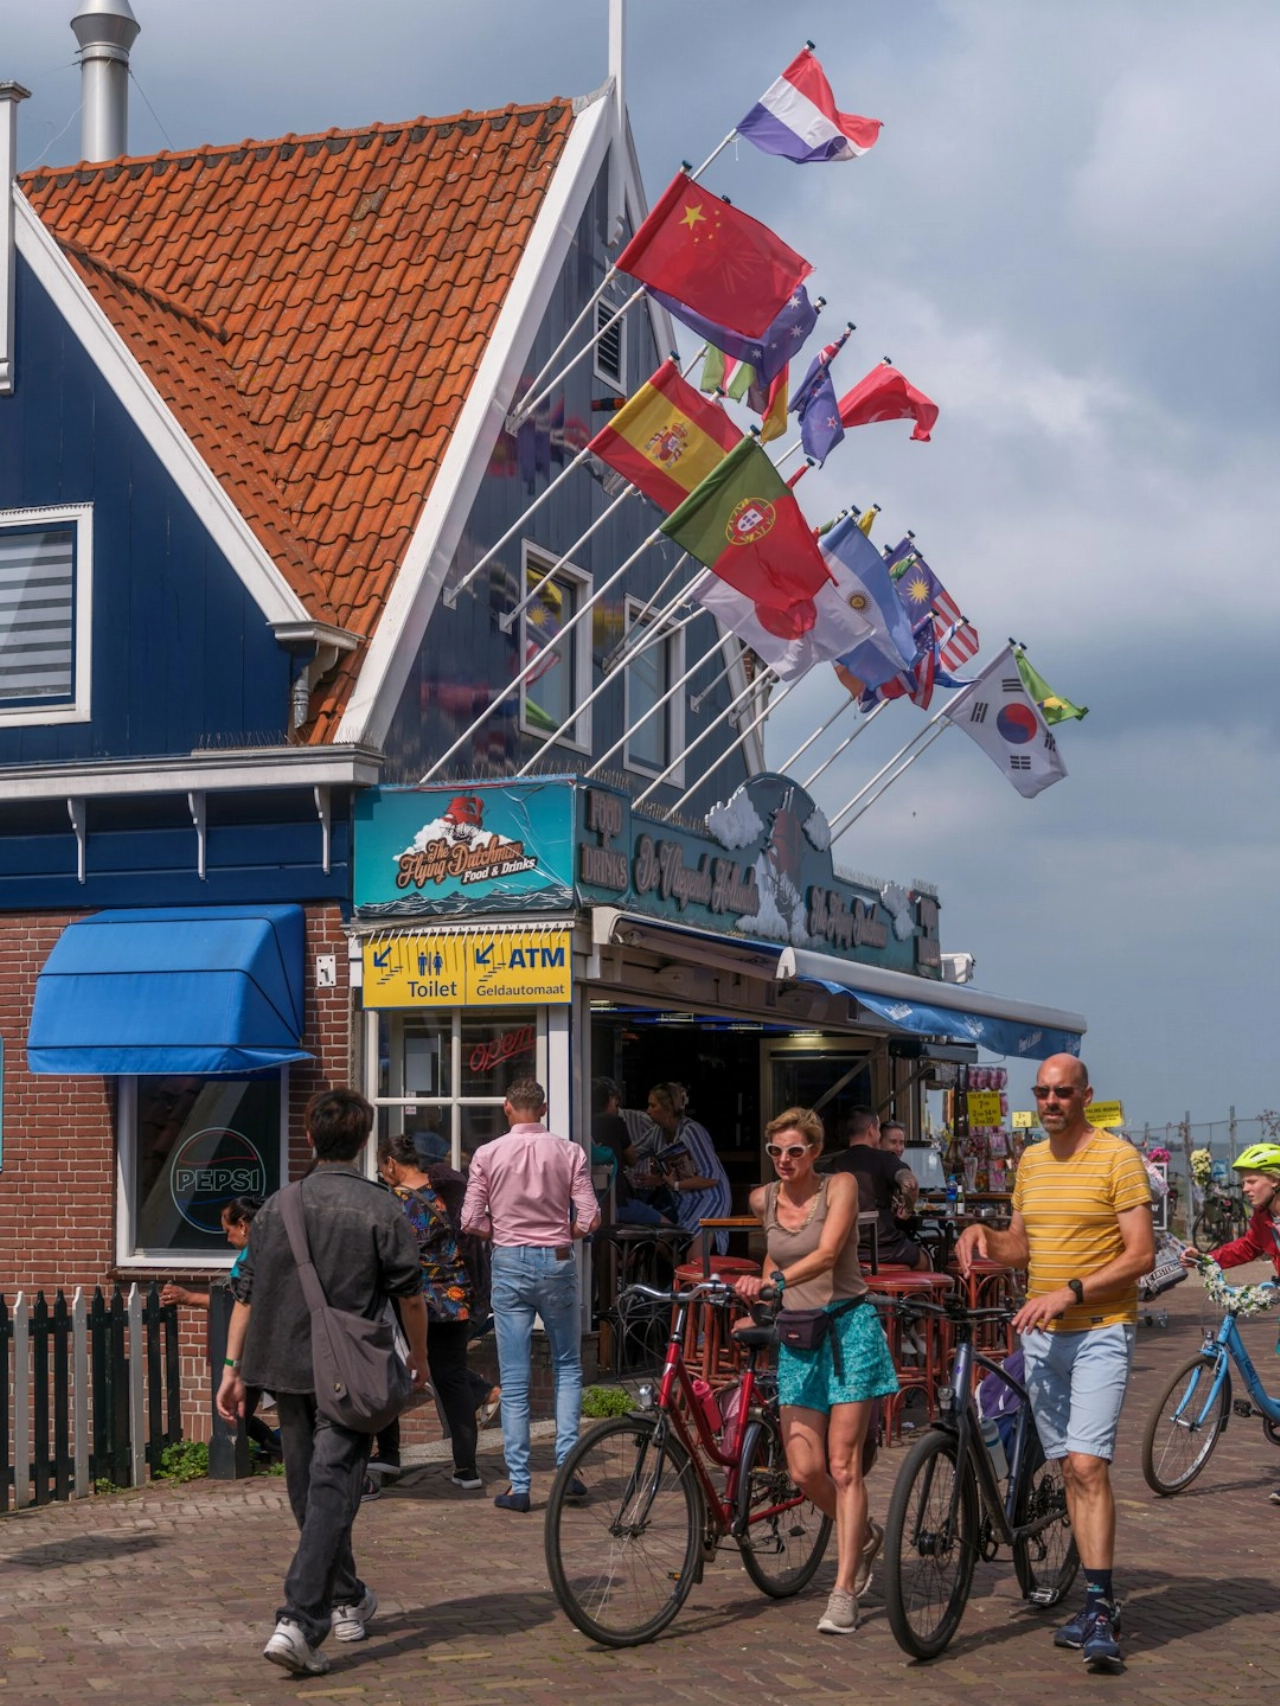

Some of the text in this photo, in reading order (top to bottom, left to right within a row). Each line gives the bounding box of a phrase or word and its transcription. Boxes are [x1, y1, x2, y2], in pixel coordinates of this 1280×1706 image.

[397, 835, 524, 888] Flying Dutchman
[428, 839, 450, 862] The
[463, 857, 536, 884] Food & Drinks
[585, 848, 628, 889] DRINKS
[508, 947, 565, 969] ATM
[407, 980, 457, 998] Toilet
[476, 983, 565, 997] Geldautomaat
[176, 1168, 260, 1192] PEPSI
